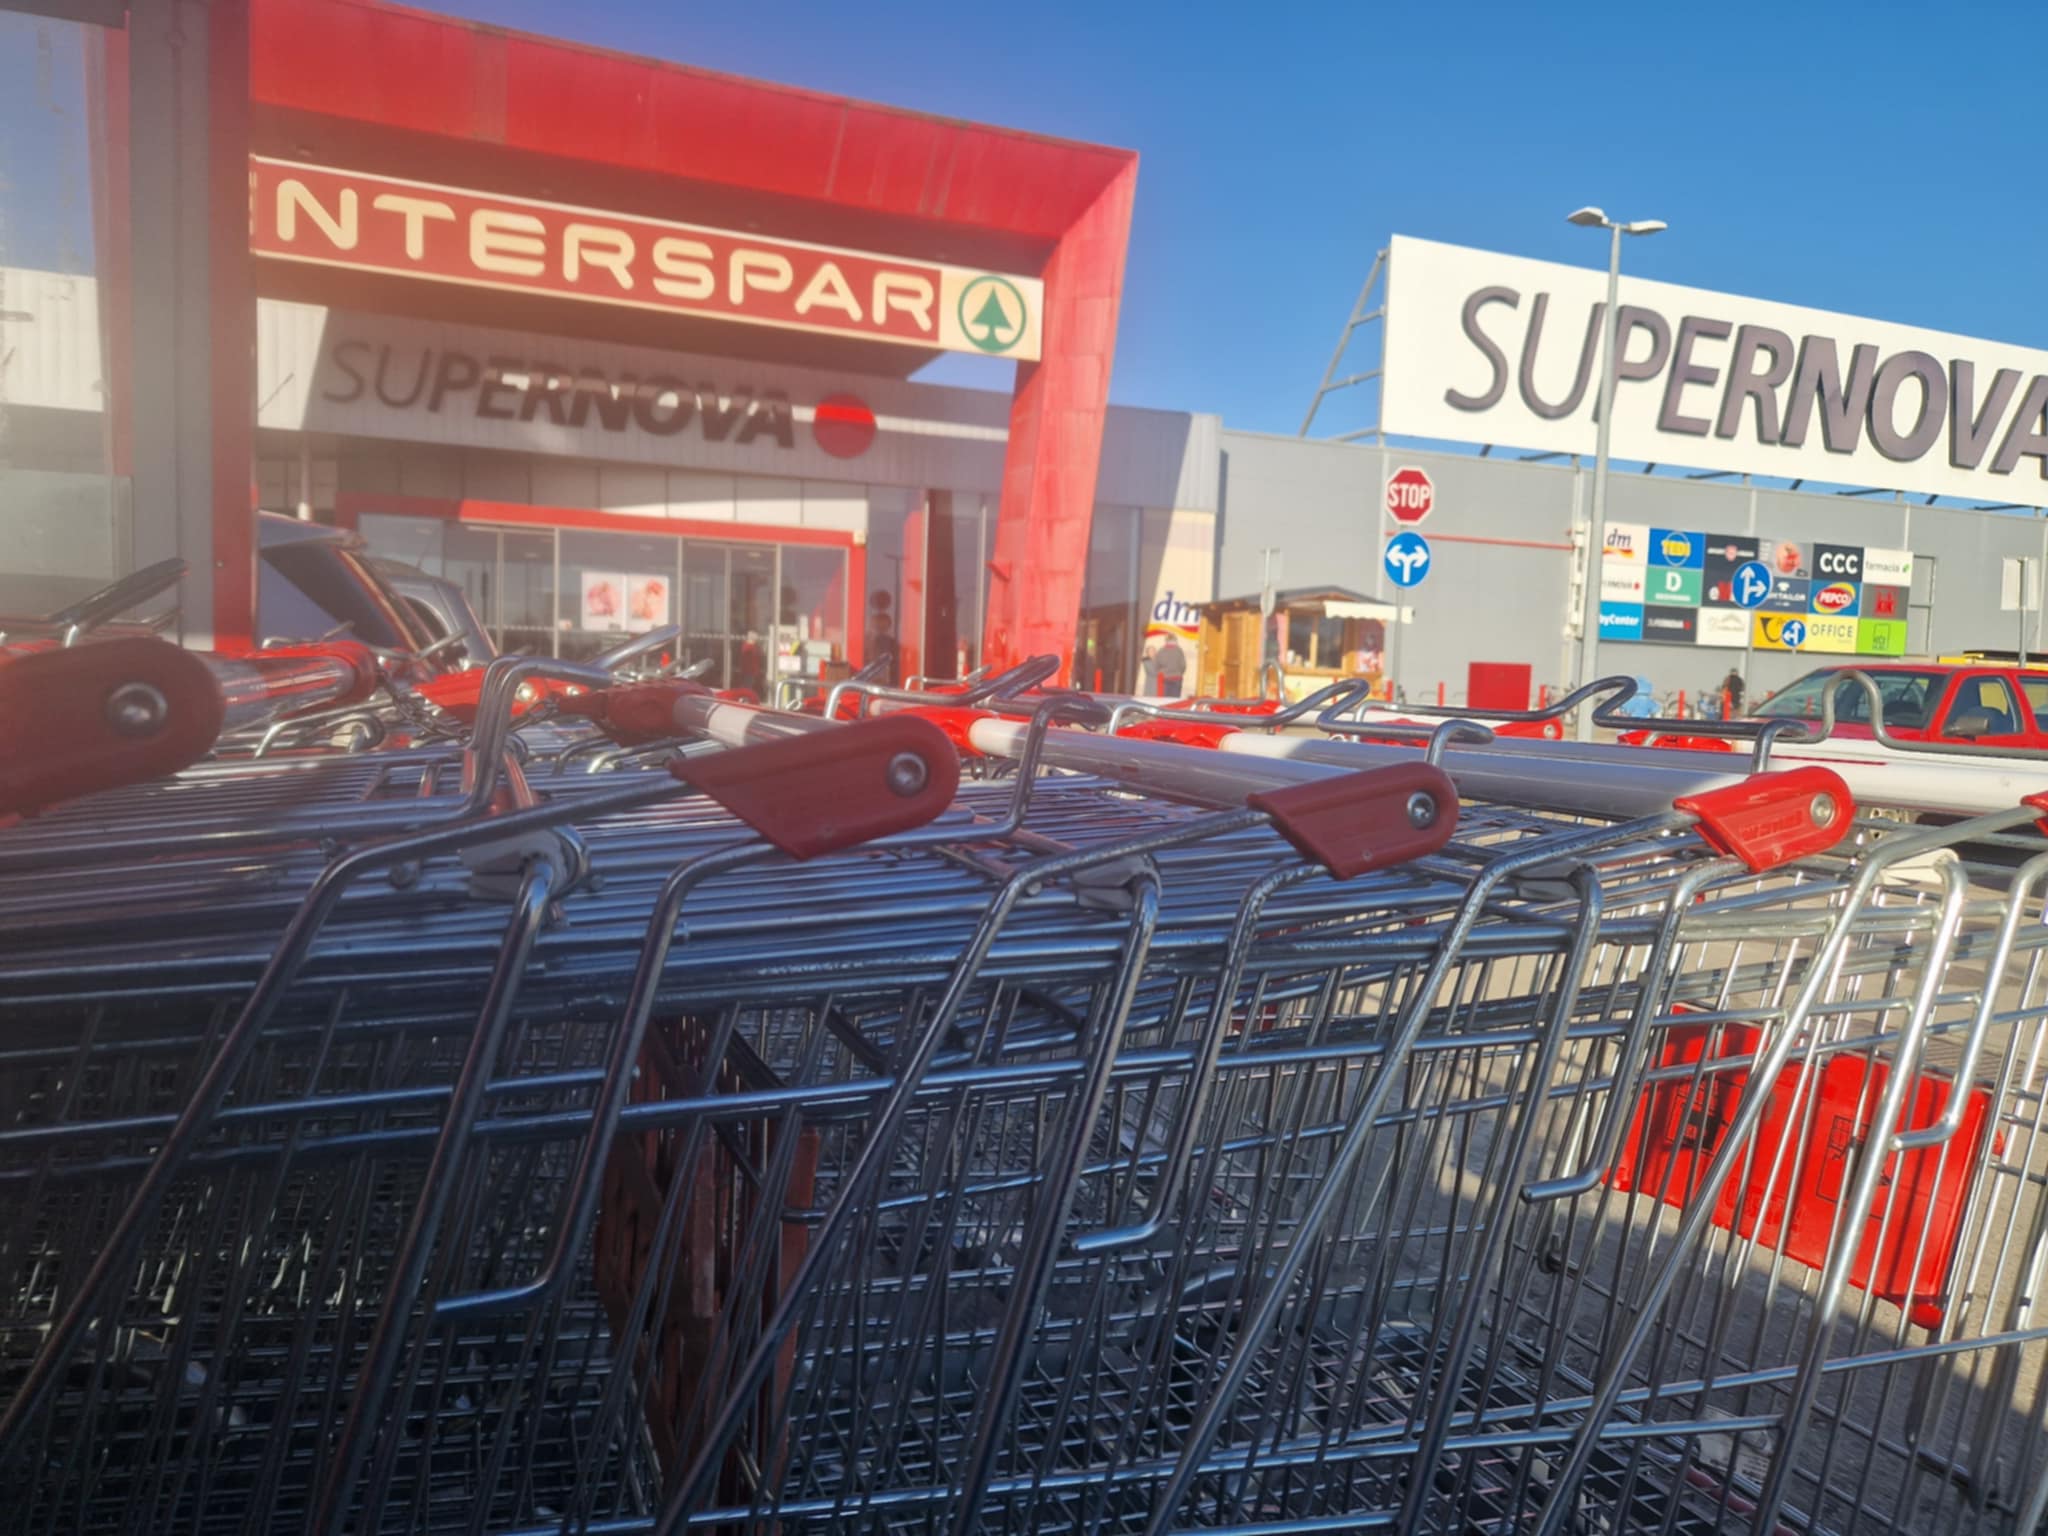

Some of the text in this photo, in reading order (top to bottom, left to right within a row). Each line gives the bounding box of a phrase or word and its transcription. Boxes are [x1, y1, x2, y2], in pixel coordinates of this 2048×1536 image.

[250, 172, 933, 332] NTERSPAR
[321, 340, 796, 449] SUPERNOVA
[1443, 285, 2048, 481] SUPERNOVA
[1388, 482, 1431, 508] STOP
[1607, 528, 1632, 547] dm
[1819, 552, 1859, 574] CCC
[1665, 571, 1683, 592] D
[1154, 591, 1200, 622] dm
[1811, 623, 1853, 638] OFFICE
